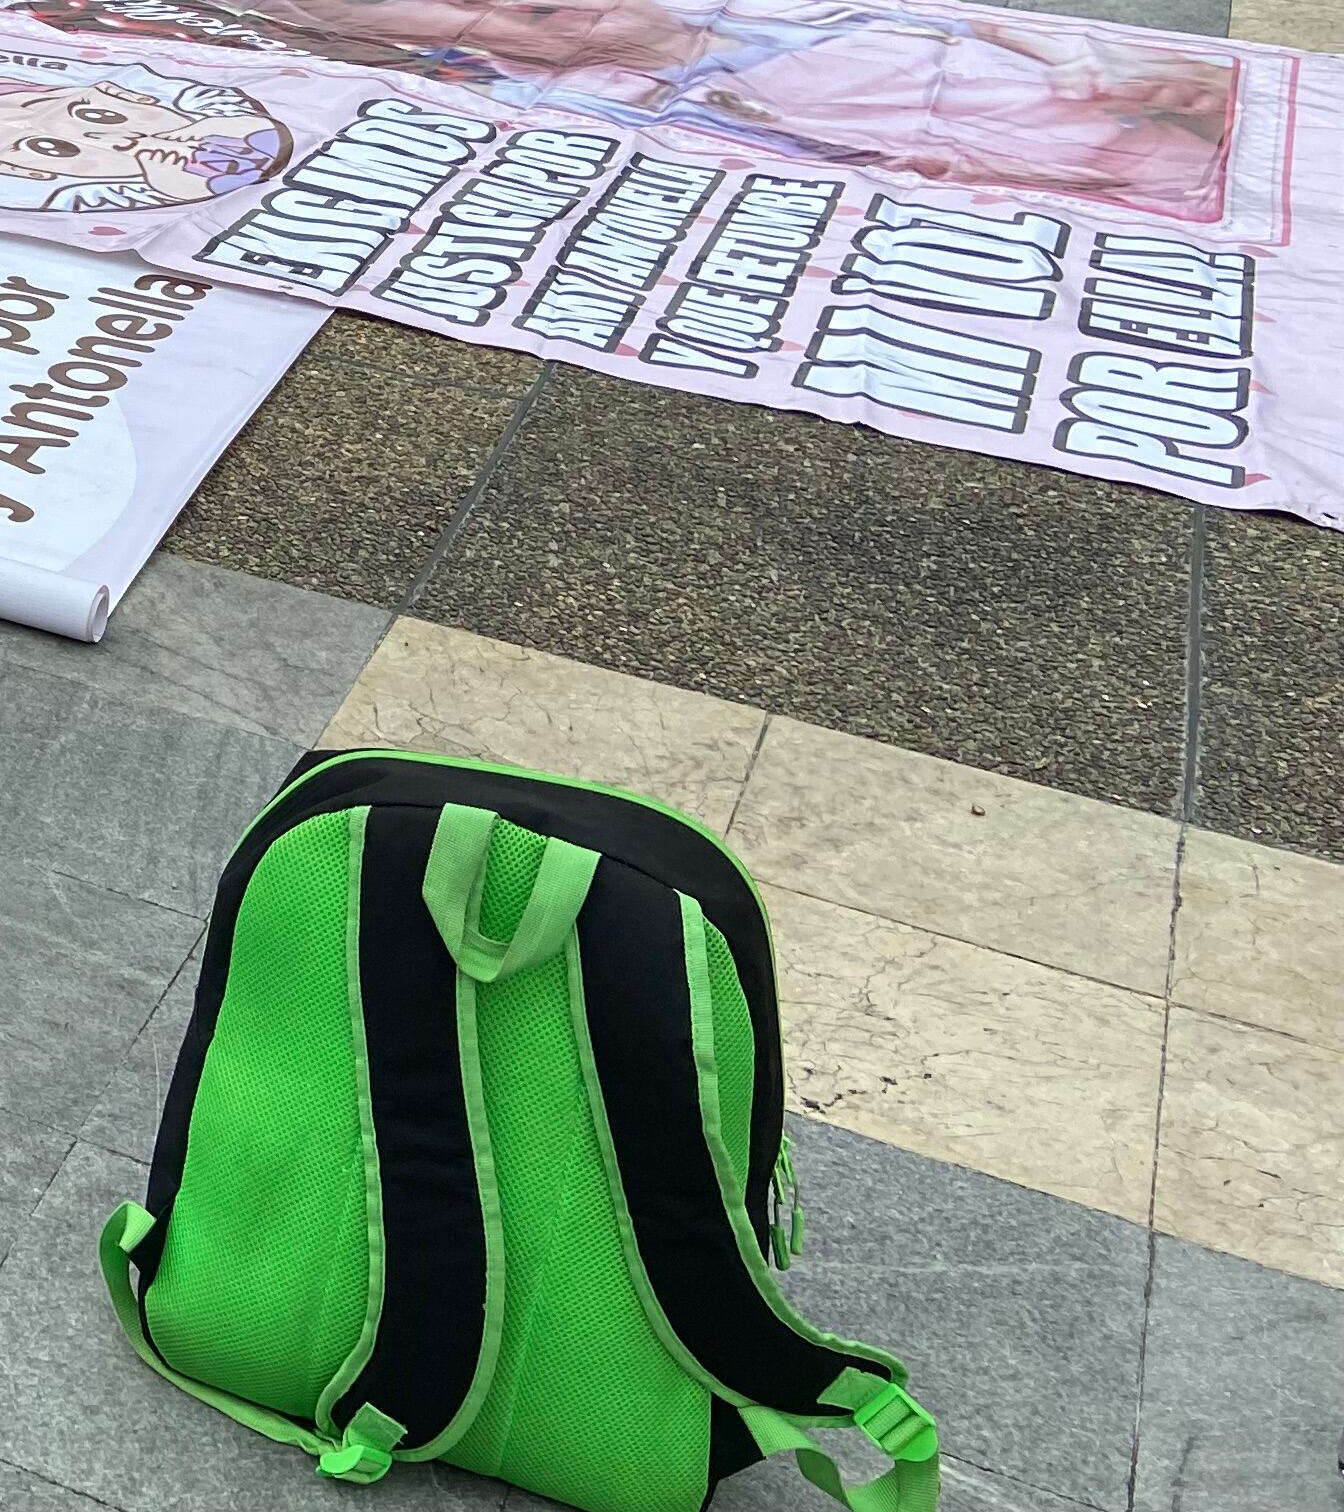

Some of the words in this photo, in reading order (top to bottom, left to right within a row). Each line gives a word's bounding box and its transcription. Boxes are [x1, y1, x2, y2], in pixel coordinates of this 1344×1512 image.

[193, 98, 497, 297] EXIGIMOS
[370, 178, 592, 326] JUSTICIA
[481, 129, 622, 196] POR
[556, 152, 727, 291] ANTONELLA
[686, 173, 845, 298] RETUMBE
[831, 193, 1072, 321] VOZ
[513, 266, 646, 352] AMY
[637, 332, 759, 379] Y
[655, 282, 790, 353] QUE
[1078, 232, 1257, 359] ELLA!
[792, 304, 1042, 434] MI
[1053, 350, 1251, 488] POR
